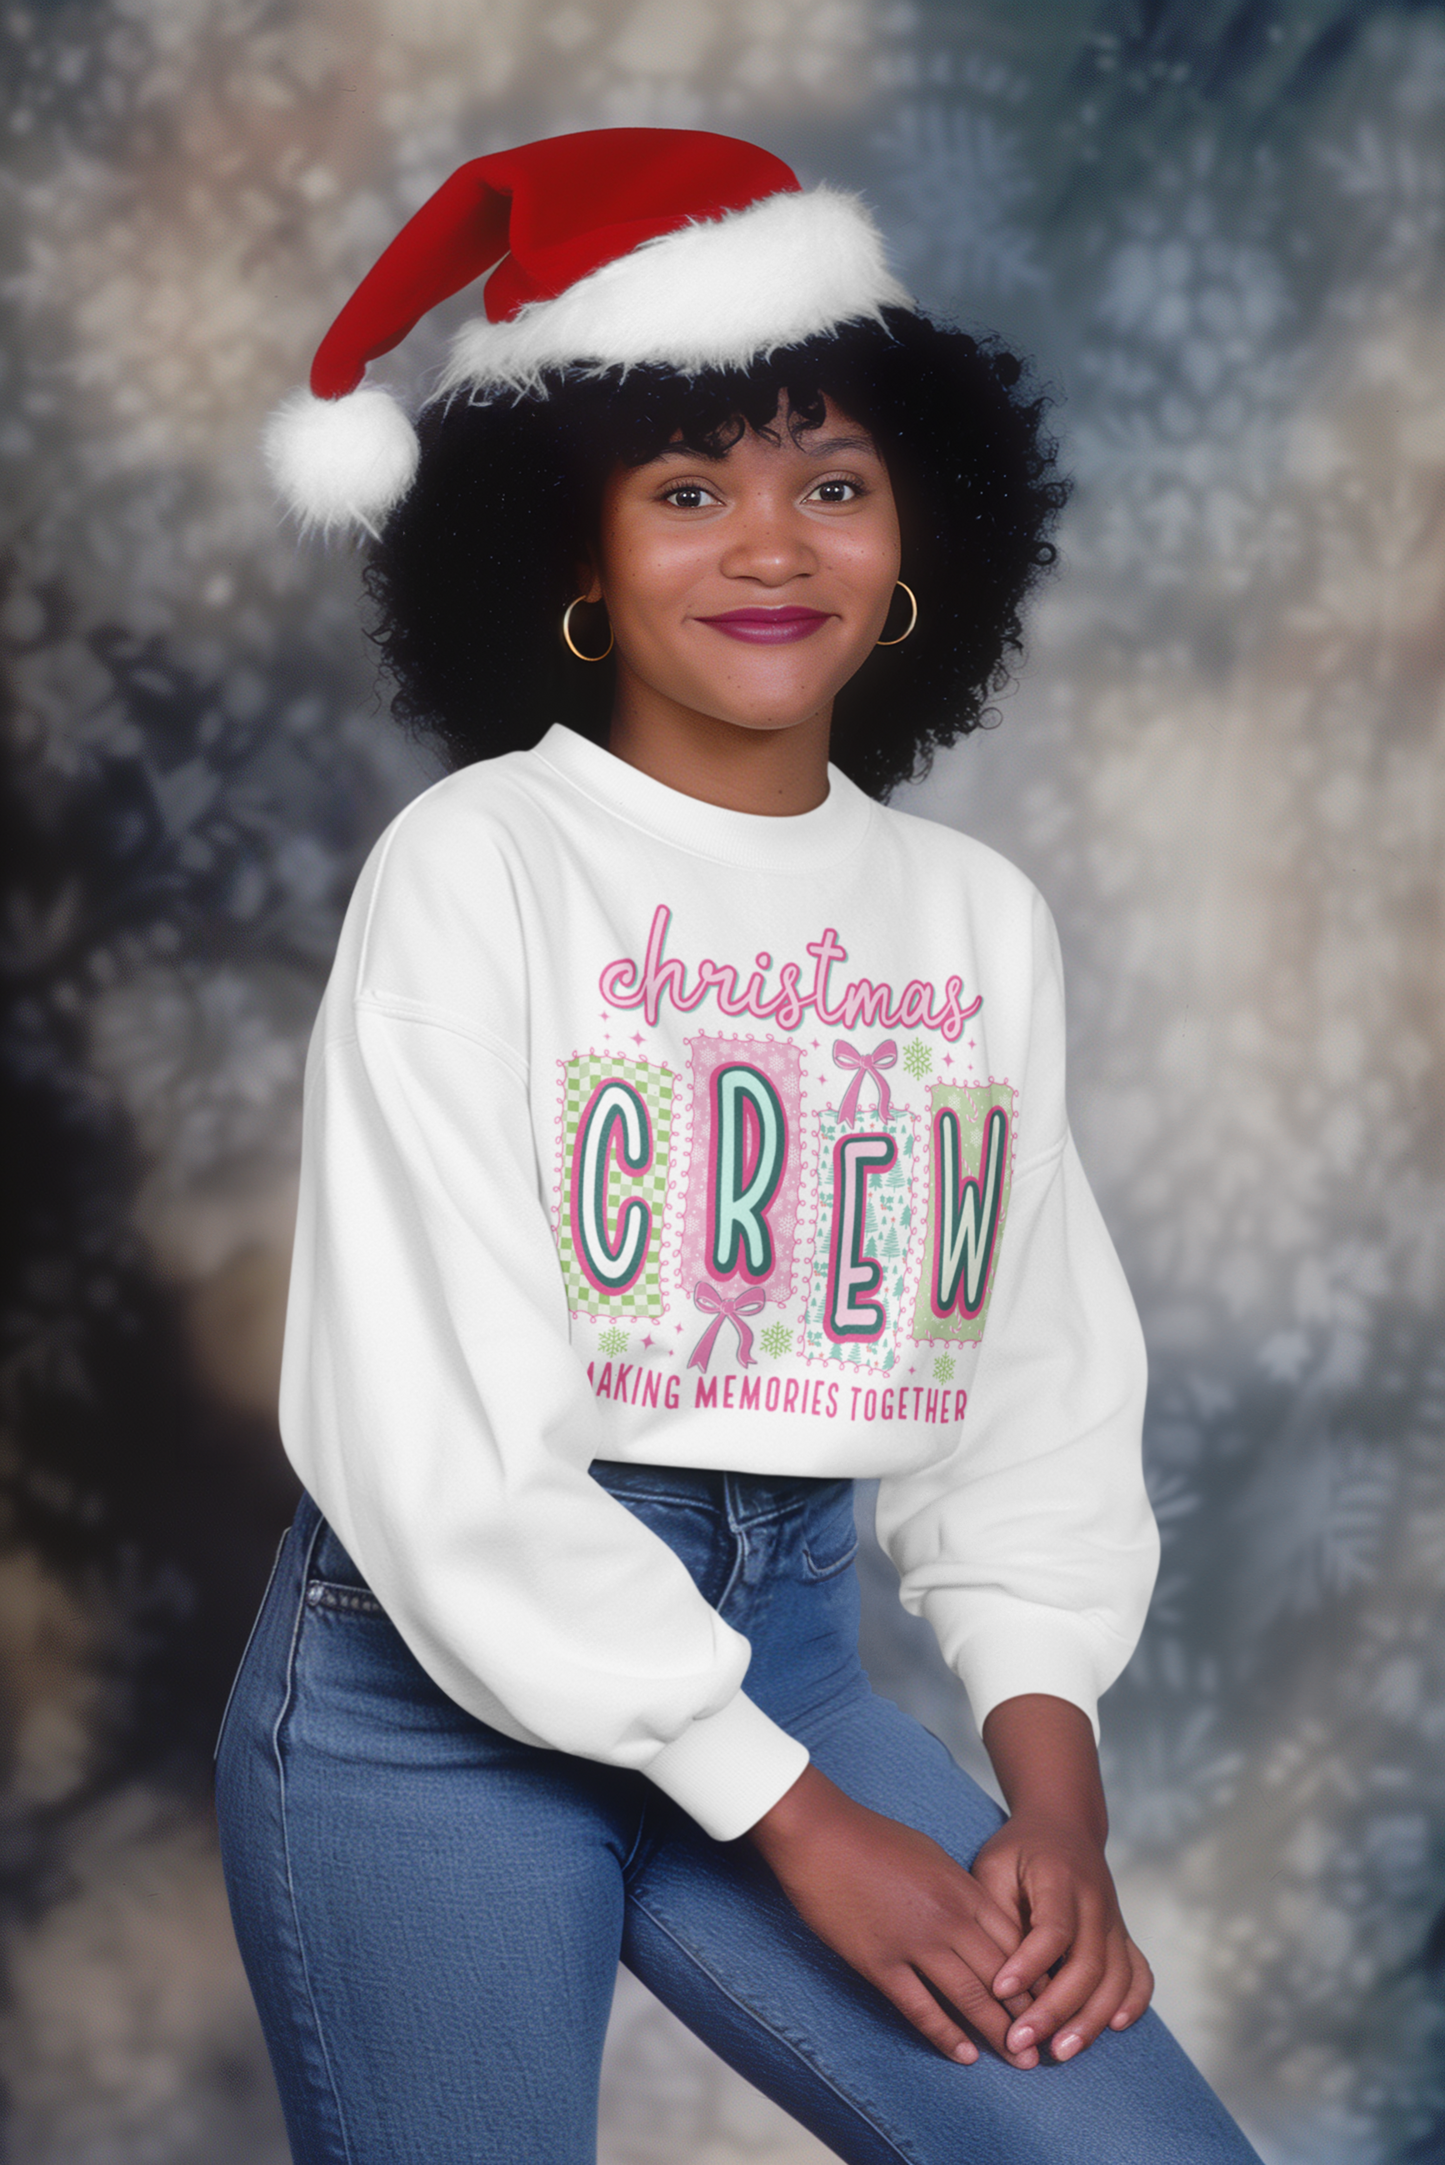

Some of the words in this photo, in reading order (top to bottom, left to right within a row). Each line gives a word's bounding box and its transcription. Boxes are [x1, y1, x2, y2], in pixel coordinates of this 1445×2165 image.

[599, 904, 984, 1042] christmas
[571, 1063, 1007, 1343] CREW
[695, 1375, 839, 1418] MEMORIES
[851, 1386, 967, 1424] TOGETHER
